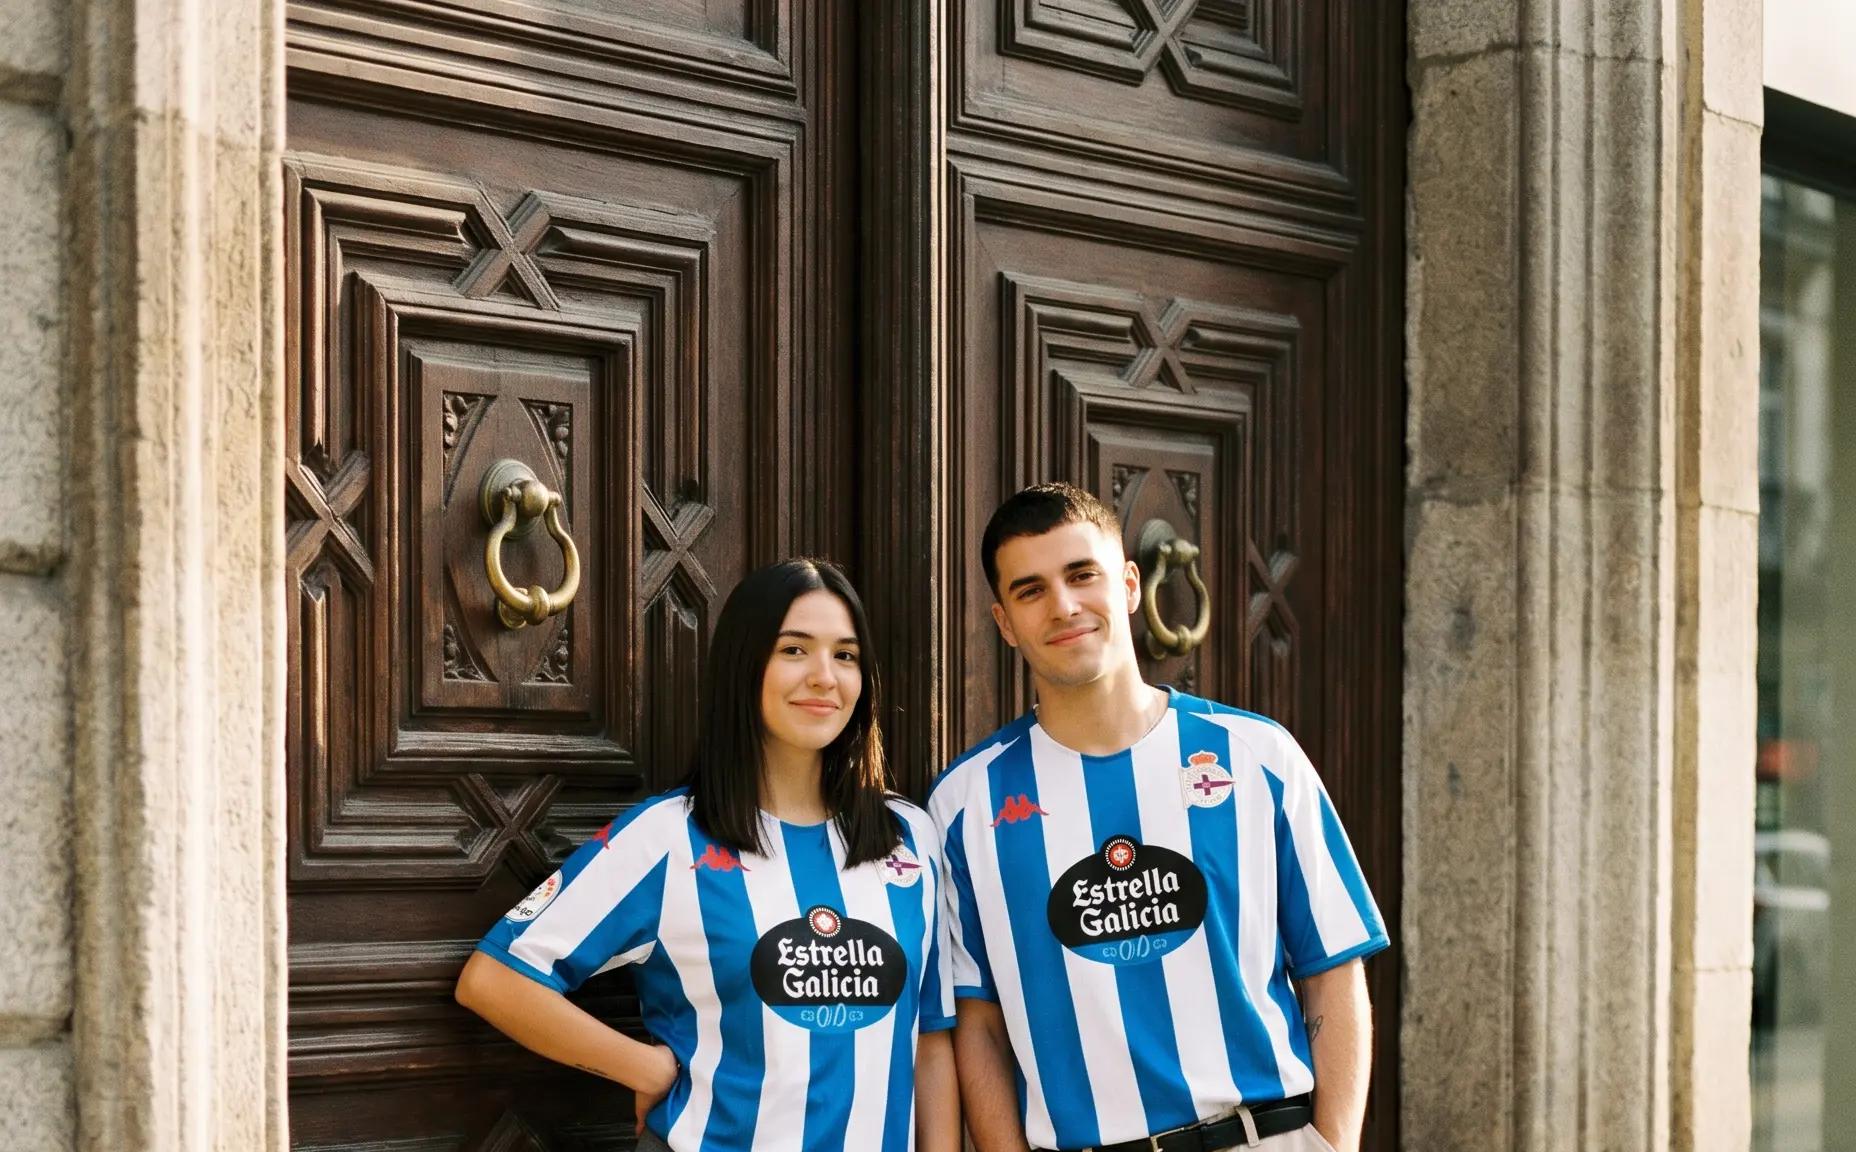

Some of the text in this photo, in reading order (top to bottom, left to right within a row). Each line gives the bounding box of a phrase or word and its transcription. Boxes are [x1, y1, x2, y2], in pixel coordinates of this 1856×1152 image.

[1072, 867, 1181, 908] Estrella
[1080, 897, 1180, 937] Galicia
[777, 937, 884, 967] Estrella
[782, 967, 879, 999] Galicia
